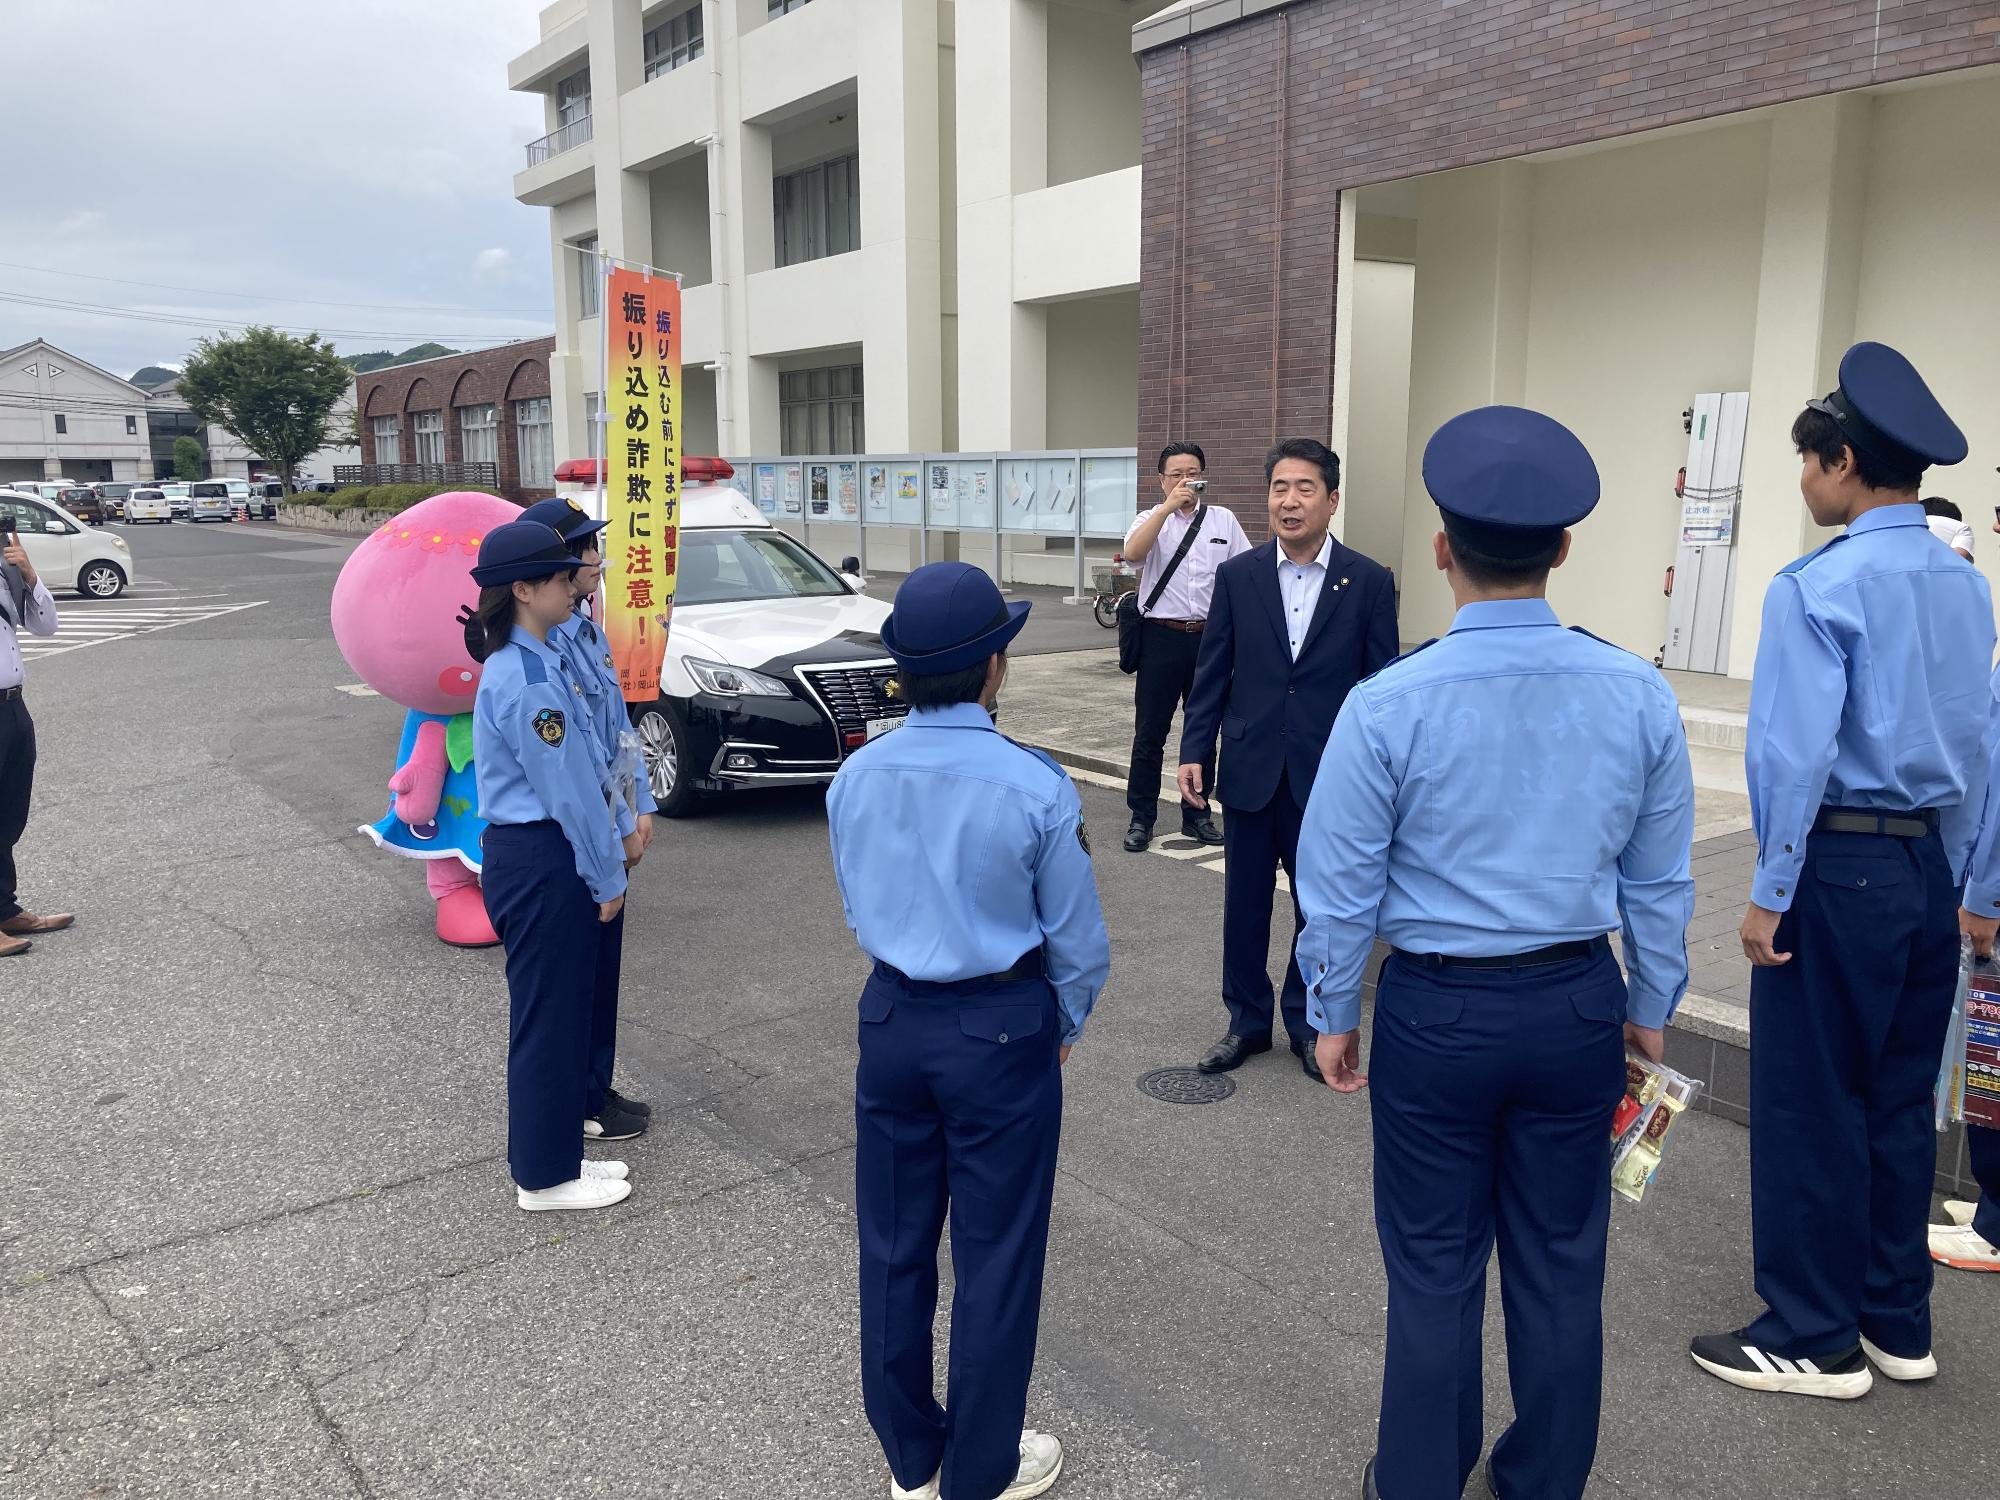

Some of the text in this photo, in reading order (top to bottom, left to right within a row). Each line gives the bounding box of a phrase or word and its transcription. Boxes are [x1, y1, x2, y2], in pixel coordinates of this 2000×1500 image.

[623, 291, 655, 645] 振り込め詐欺に注意！
